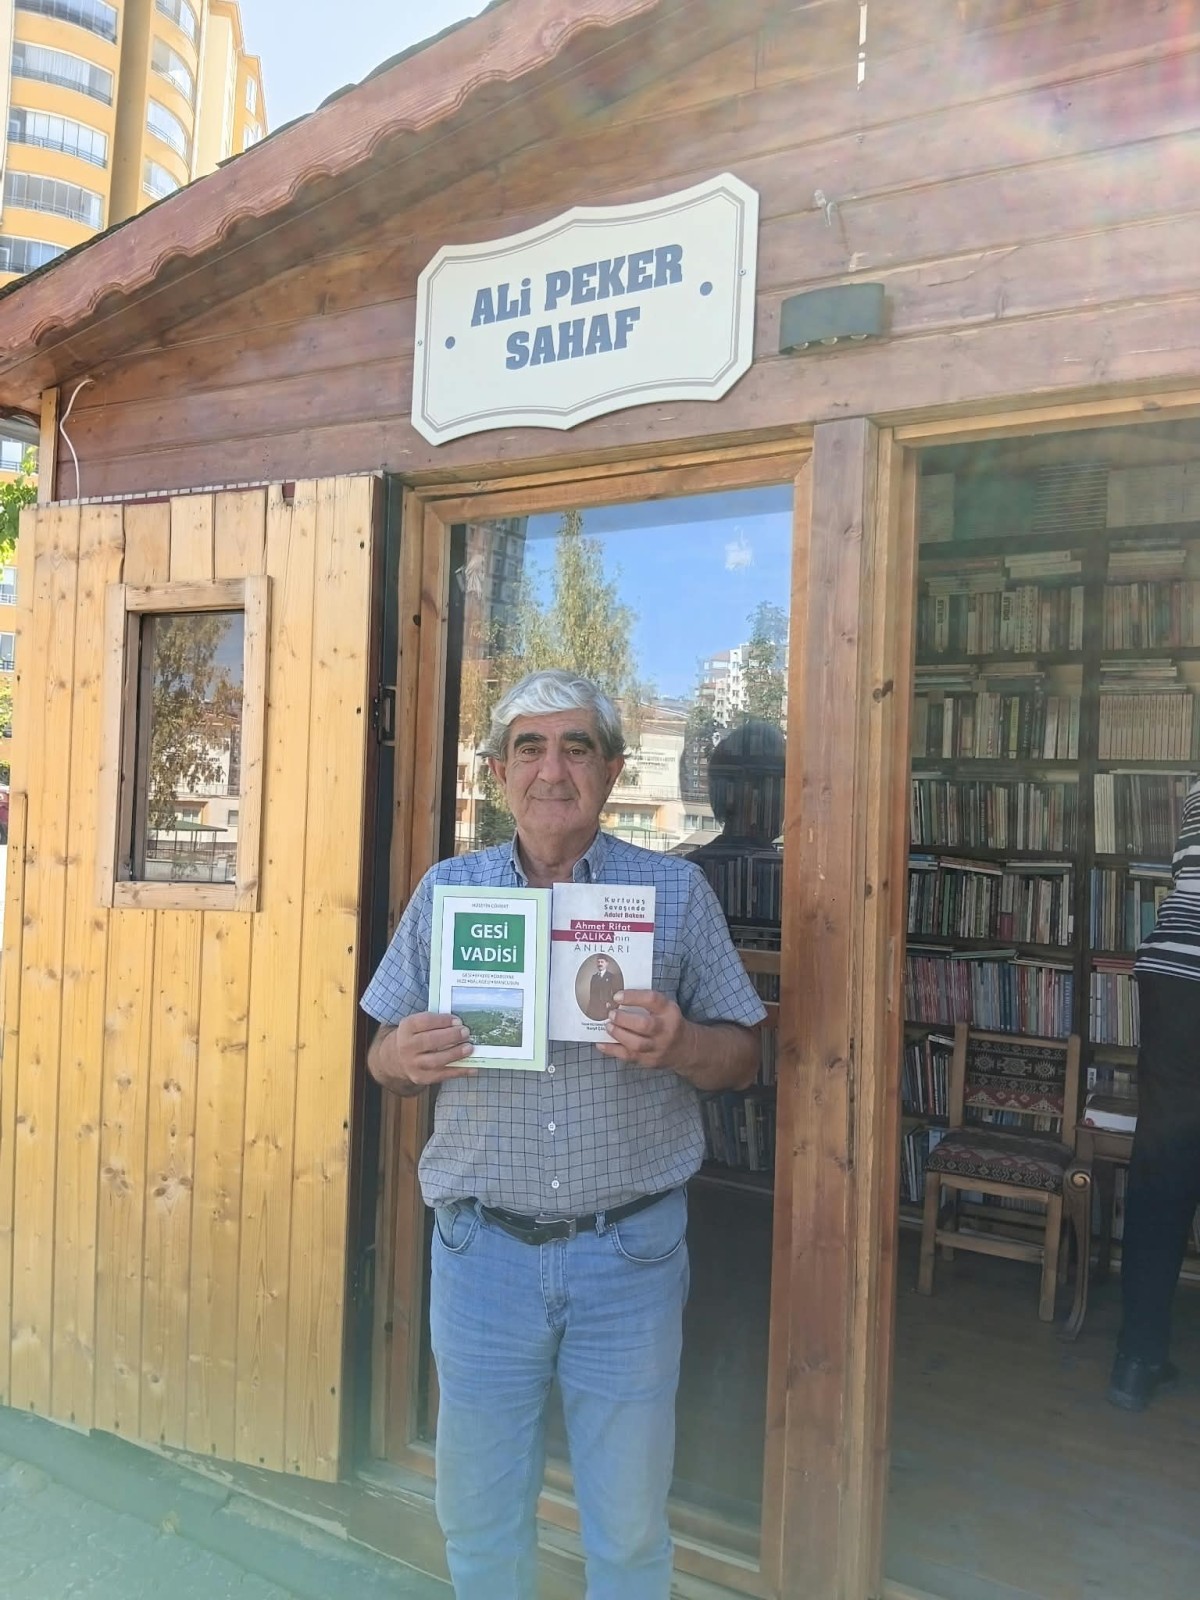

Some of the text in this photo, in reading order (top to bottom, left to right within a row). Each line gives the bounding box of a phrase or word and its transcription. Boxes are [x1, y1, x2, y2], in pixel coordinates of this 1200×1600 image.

[544, 243, 683, 311] PEKER
[505, 306, 641, 370] SAHAF
[470, 921, 508, 940] GESİ
[574, 921, 605, 930] Ahmet
[460, 944, 517, 963] VADİSİ
[574, 943, 630, 953] ANILARI
